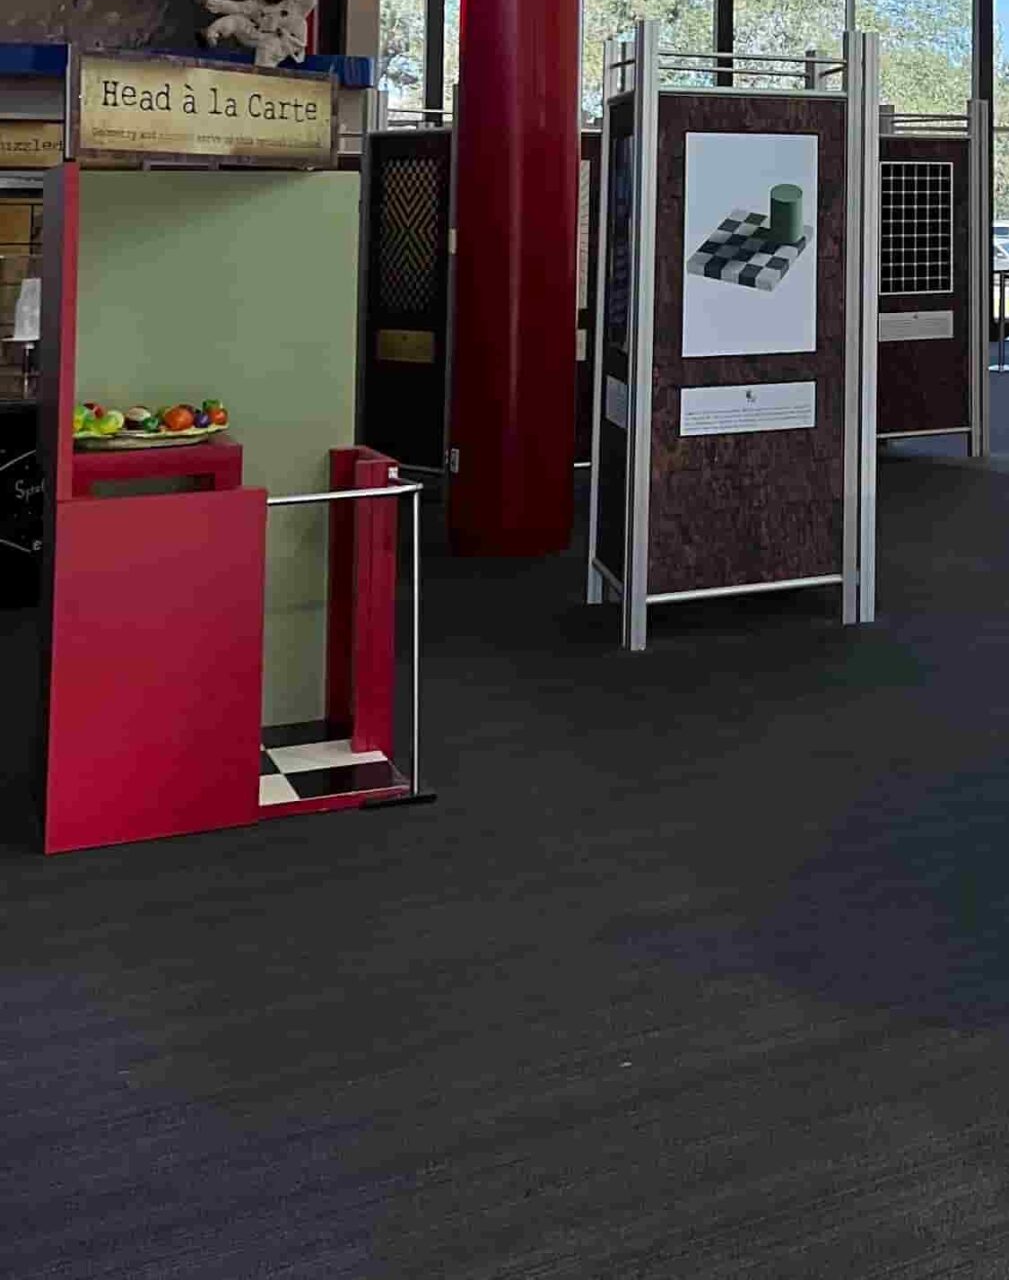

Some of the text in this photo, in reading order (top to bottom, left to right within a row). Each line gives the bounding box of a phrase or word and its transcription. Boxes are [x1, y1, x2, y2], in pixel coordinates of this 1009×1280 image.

[101, 80, 317, 122] Head à la Carte
